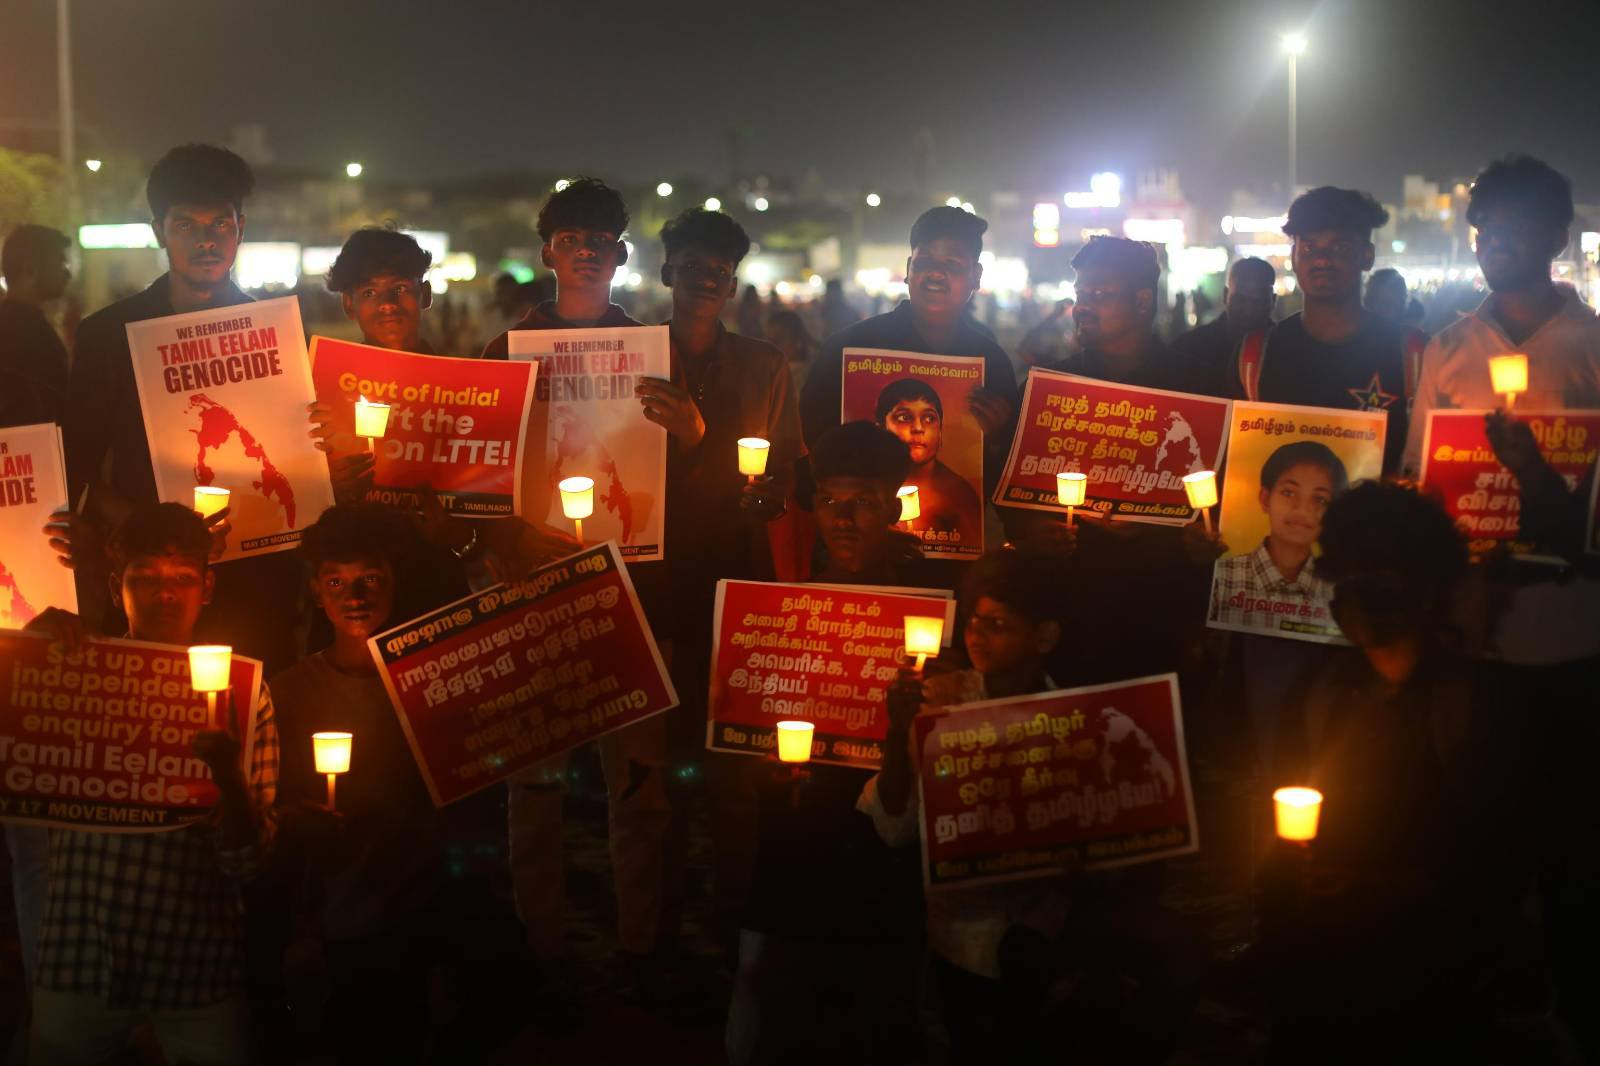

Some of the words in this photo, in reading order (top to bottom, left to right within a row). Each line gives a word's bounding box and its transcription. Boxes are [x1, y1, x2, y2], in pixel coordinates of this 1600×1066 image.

[176, 327, 195, 340] WE
[196, 316, 252, 336] REMEMBER
[157, 338, 216, 366] TAMIL
[220, 327, 278, 358] EELAM
[554, 341, 570, 353] WE
[571, 340, 624, 353] REMEMBER
[164, 349, 282, 394] GENOCIDE
[537, 355, 586, 376] TAMIL
[591, 353, 645, 374] EELAM
[848, 359, 902, 374] தமிழீழம்
[909, 364, 979, 380] வெல்வோம்
[339, 372, 398, 399] Govt
[403, 378, 430, 401] of
[433, 379, 500, 407] India!
[420, 405, 474, 435] the
[1047, 393, 1089, 414] ஈழத்
[1094, 399, 1158, 424] தமிழர்
[1036, 411, 1159, 446] பிரச்சனைக்கு
[1240, 418, 1295, 436] தமிழீழம்
[1299, 424, 1377, 442] வெல்வோம்
[432, 439, 511, 467] LTTE!
[1048, 436, 1088, 456] ஒரே
[1092, 441, 1138, 464] தீர்வு
[1088, 462, 1184, 494] தமிழீழமே
[576, 552, 608, 574] மே
[781, 594, 834, 620] தமிழர்
[842, 601, 881, 617] கடல்
[1228, 591, 1328, 618] வீரவணக்க
[386, 608, 473, 656] இயக்கம்
[396, 583, 620, 693] இனப்படுகொலையே!
[526, 614, 616, 662] ஈழத்தில்
[742, 612, 799, 632] அமைதி
[806, 616, 906, 640] பிராந்தியமா
[47, 642, 98, 668] Set
[105, 652, 144, 676] up
[151, 656, 191, 676] an
[731, 630, 833, 654] அறிவிக்கப்பட
[843, 642, 906, 664] வேண்டு
[12, 660, 207, 700] independen
[422, 651, 516, 708] நடந்தது
[728, 668, 808, 696] இந்தியப்
[819, 683, 888, 704] படைக
[860, 658, 898, 682] சீன
[10, 686, 208, 724] internationa
[761, 698, 877, 731] வெளியேறு!
[23, 714, 142, 746] enquiry
[150, 720, 196, 746] for
[724, 728, 747, 744] மே
[0, 736, 95, 769] Tamil
[104, 746, 213, 780] Eelam
[5, 765, 199, 804] Genocide.
[48, 803, 168, 824] MOVEMENT
